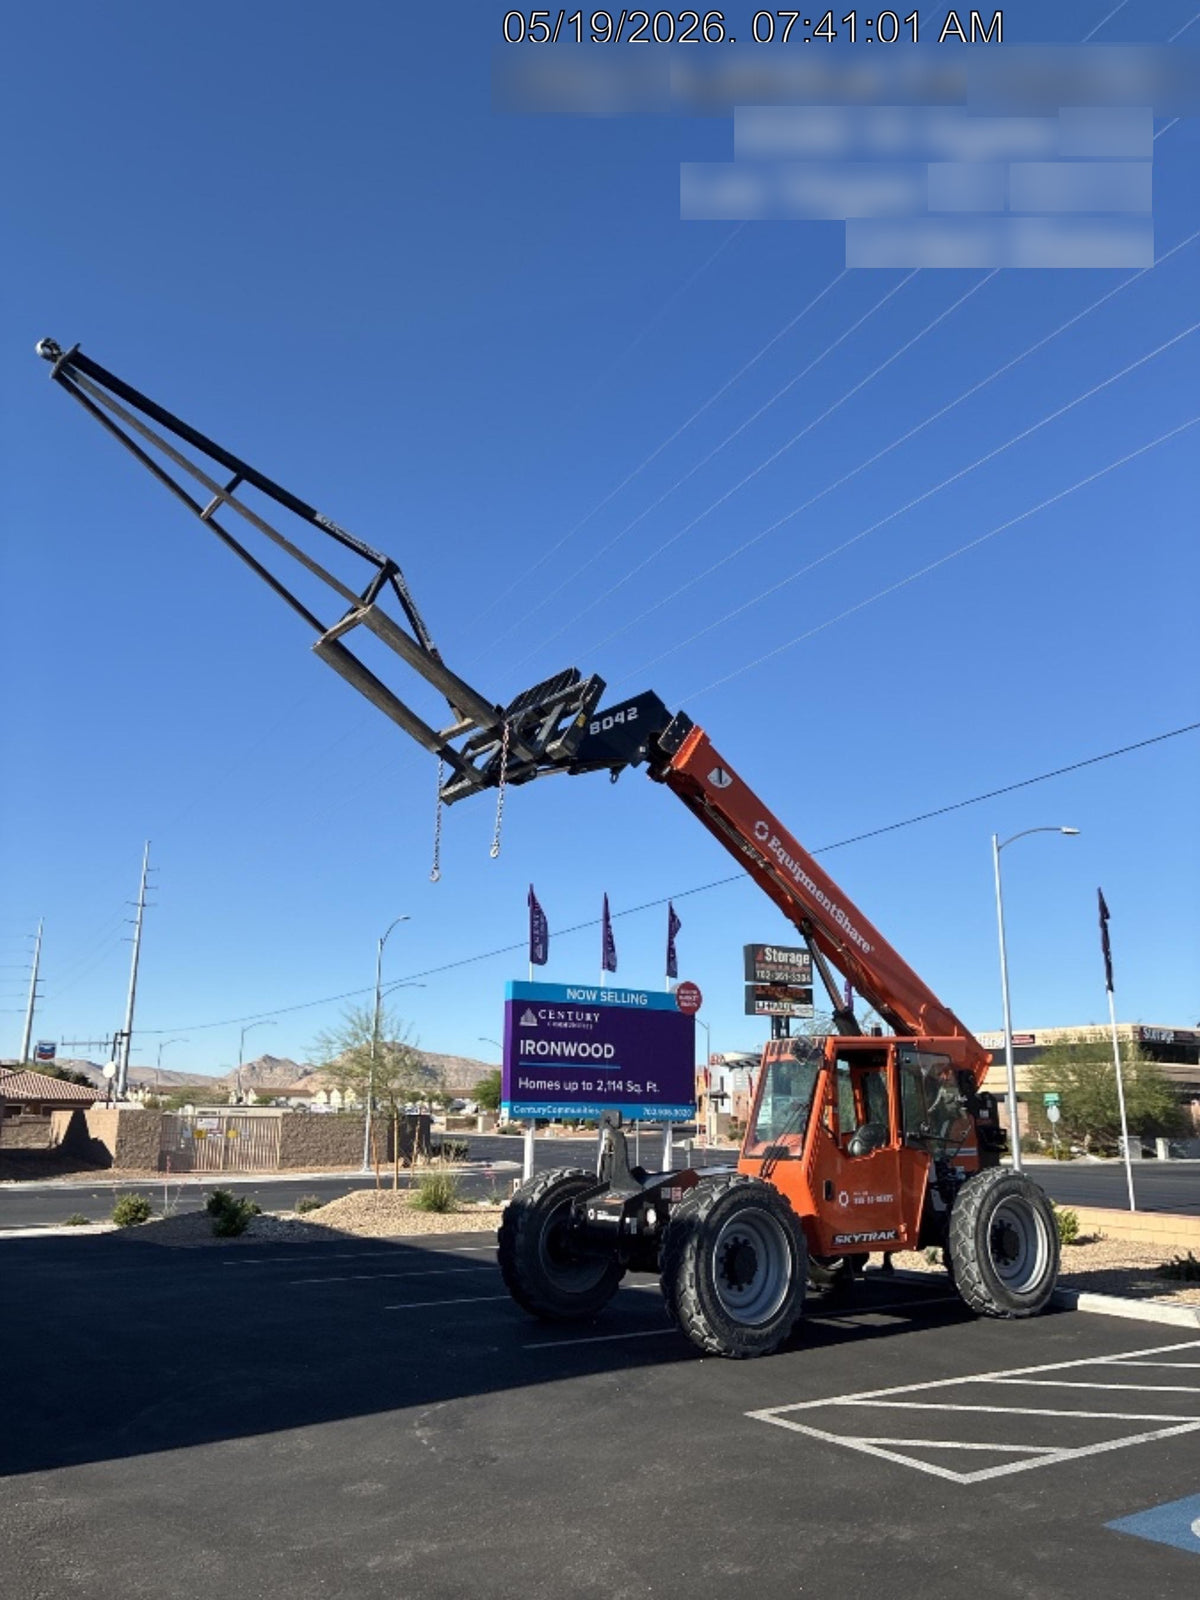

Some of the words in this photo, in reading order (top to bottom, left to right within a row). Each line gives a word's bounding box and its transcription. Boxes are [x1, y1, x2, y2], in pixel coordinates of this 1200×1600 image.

[589, 706, 639, 735] 8042
[767, 835, 871, 954] EquipmentShare
[764, 947, 810, 967] Storage
[566, 988, 597, 1001] NOW
[600, 990, 648, 1006] SELLING
[538, 1009, 600, 1023] CENTURY
[520, 1040, 615, 1059] IRONWOOD
[518, 1077, 561, 1092] Homes
[563, 1082, 578, 1093] up
[581, 1080, 593, 1091] to
[597, 1081, 623, 1093] 2,114
[646, 1081, 660, 1093] Ft.
[835, 1230, 896, 1244] SKYTRAK
